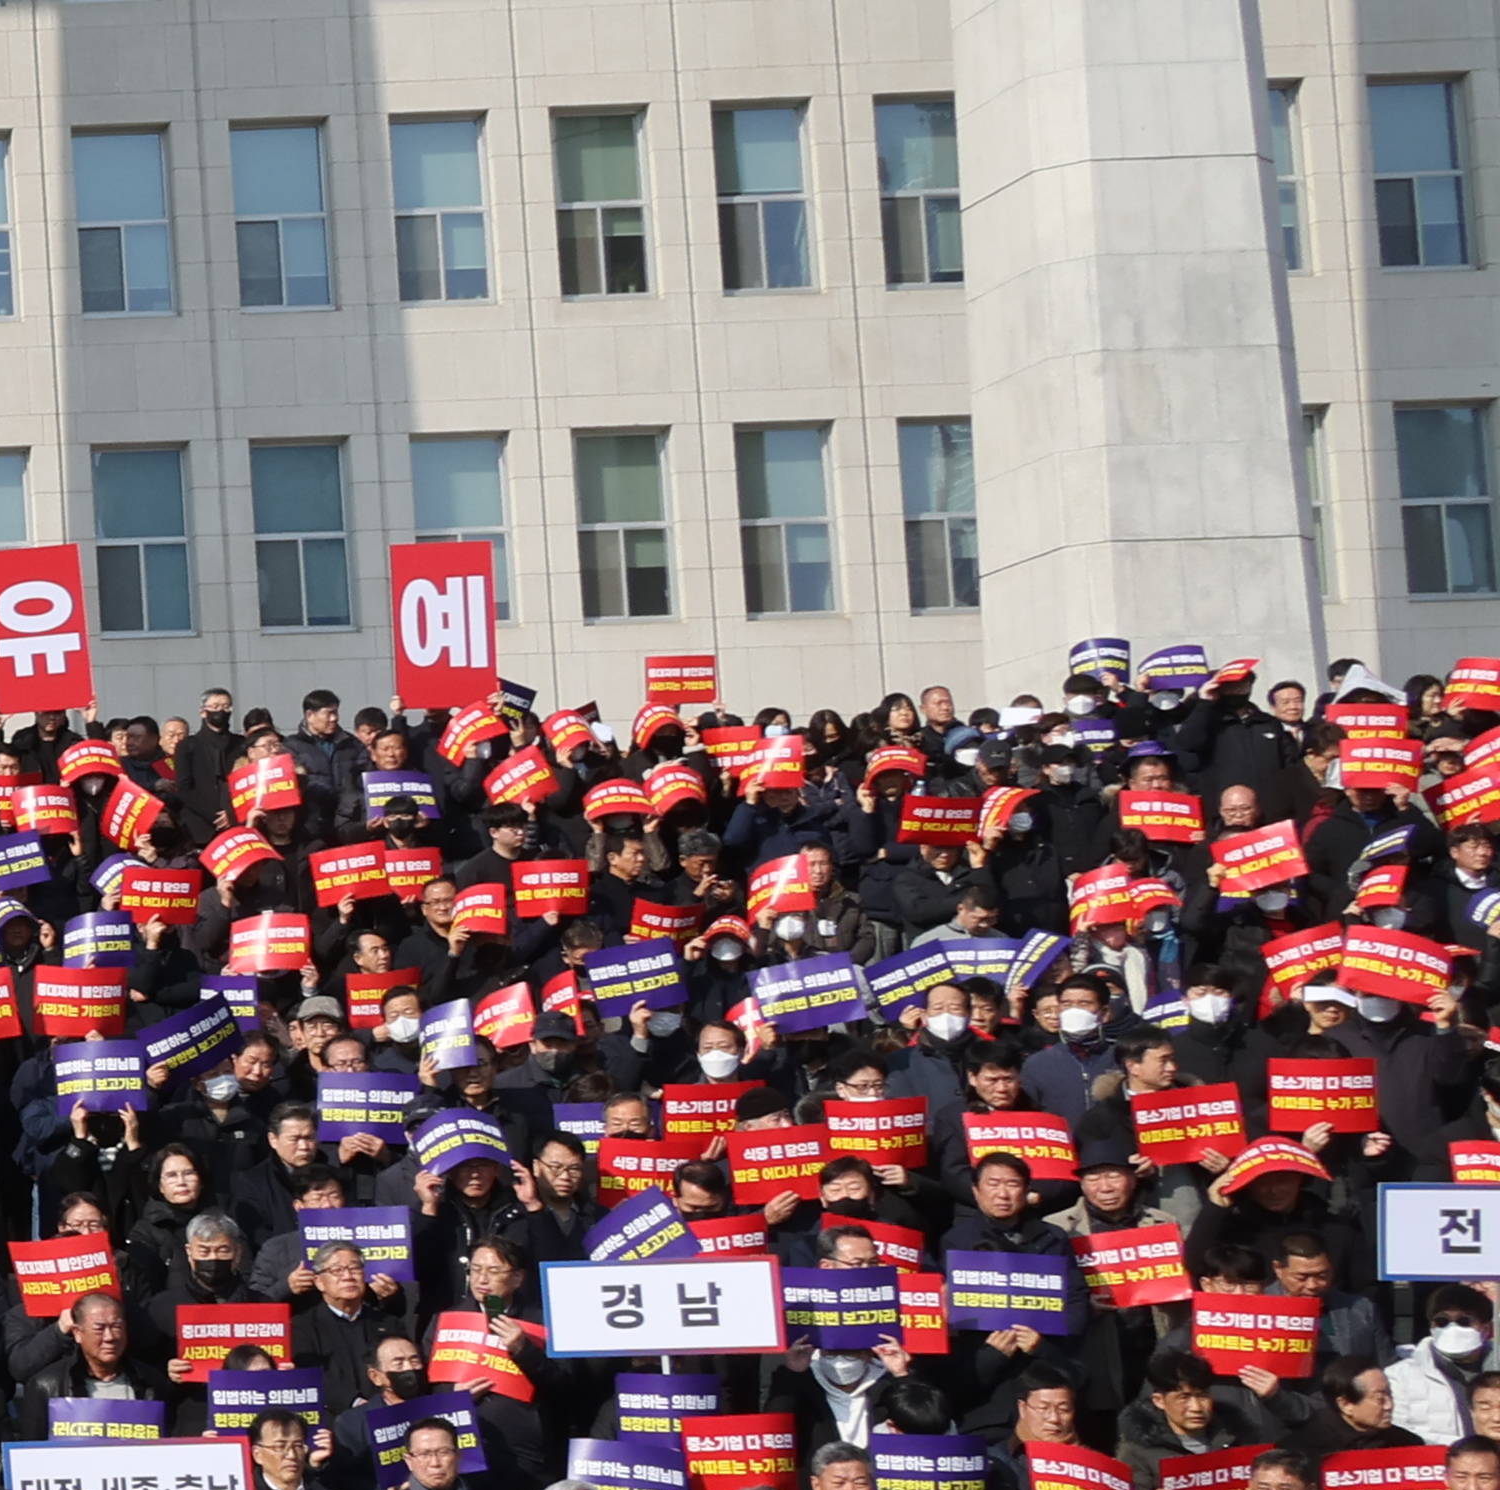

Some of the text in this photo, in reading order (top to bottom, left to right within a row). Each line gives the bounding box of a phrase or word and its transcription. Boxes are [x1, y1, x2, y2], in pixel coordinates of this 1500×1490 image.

[401, 576, 488, 668] 예
[744, 1142, 819, 1161] 식당 문 닫으면
[734, 1165, 798, 1182] 밥은 어디서
[952, 1270, 1062, 1289] 입법하는 의원님들
[784, 1286, 894, 1303] 입법하는 의원님들
[953, 1292, 1063, 1311] 현장한번 보고가라
[787, 1309, 896, 1326] 현장한번 보고가라
